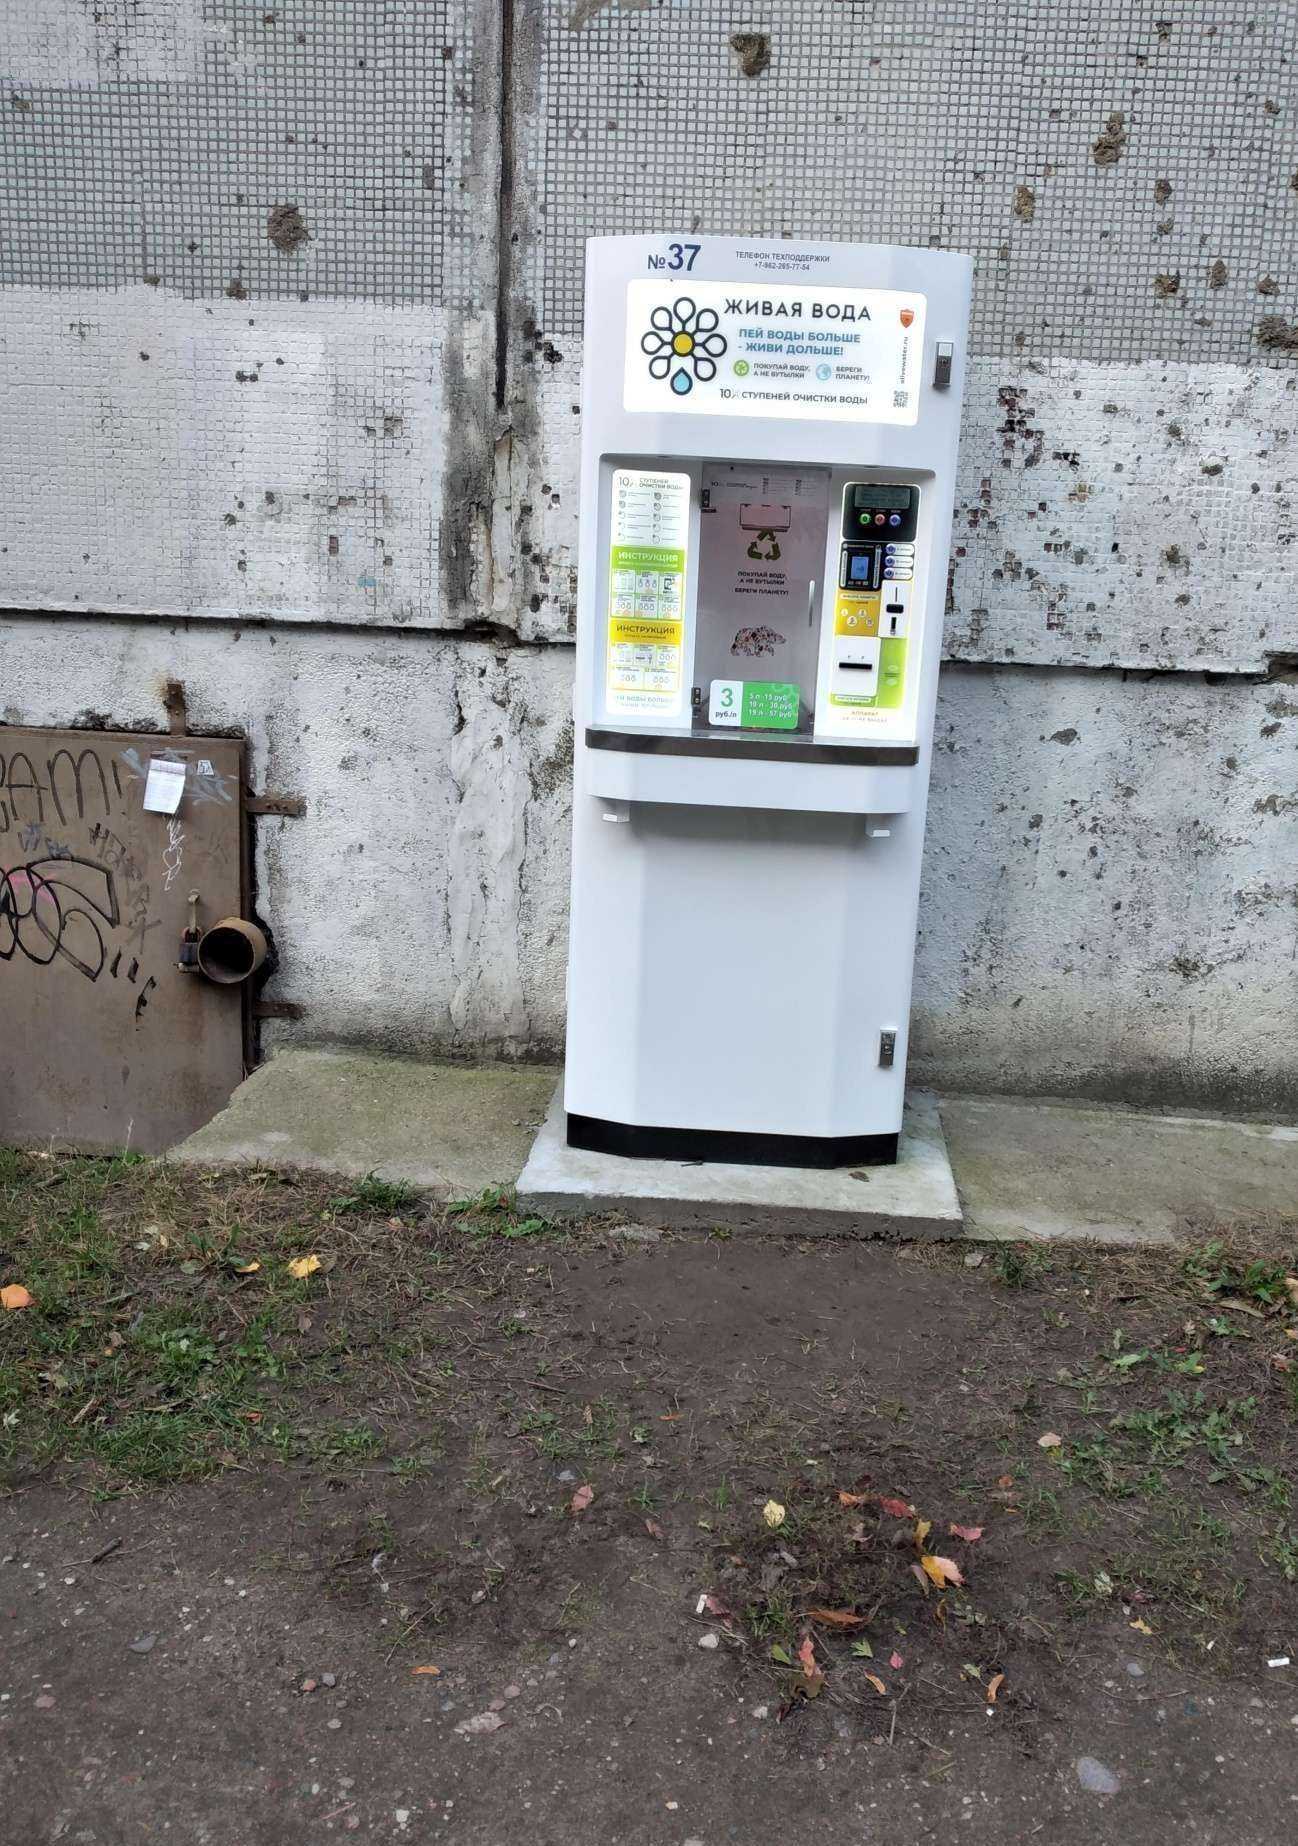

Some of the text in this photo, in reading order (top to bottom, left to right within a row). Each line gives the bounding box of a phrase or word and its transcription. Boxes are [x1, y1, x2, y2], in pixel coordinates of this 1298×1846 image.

[736, 251, 831, 264] ТЕЛЕФОН ТЕХПОДДЕРЖКИ
[724, 299, 872, 322] ЖИВАЯ ВОДА
[738, 328, 861, 344] ПЕЙ ВОДЫ БОЛЬШЕ
[746, 342, 783, 353] ЖИВИ
[786, 344, 844, 356] ДОЛЬШЕ!
[753, 363, 788, 371] ПОКУПАЙ
[742, 391, 790, 401] СТУПЕНЕЙ
[793, 394, 837, 404] ОЧИСТКИ
[839, 396, 868, 405] ВОДЫ
[618, 551, 678, 563] ИНСТРУКЦИЯ
[616, 624, 675, 635] ИНСТРУКЦИЯ
[721, 687, 733, 707] 3
